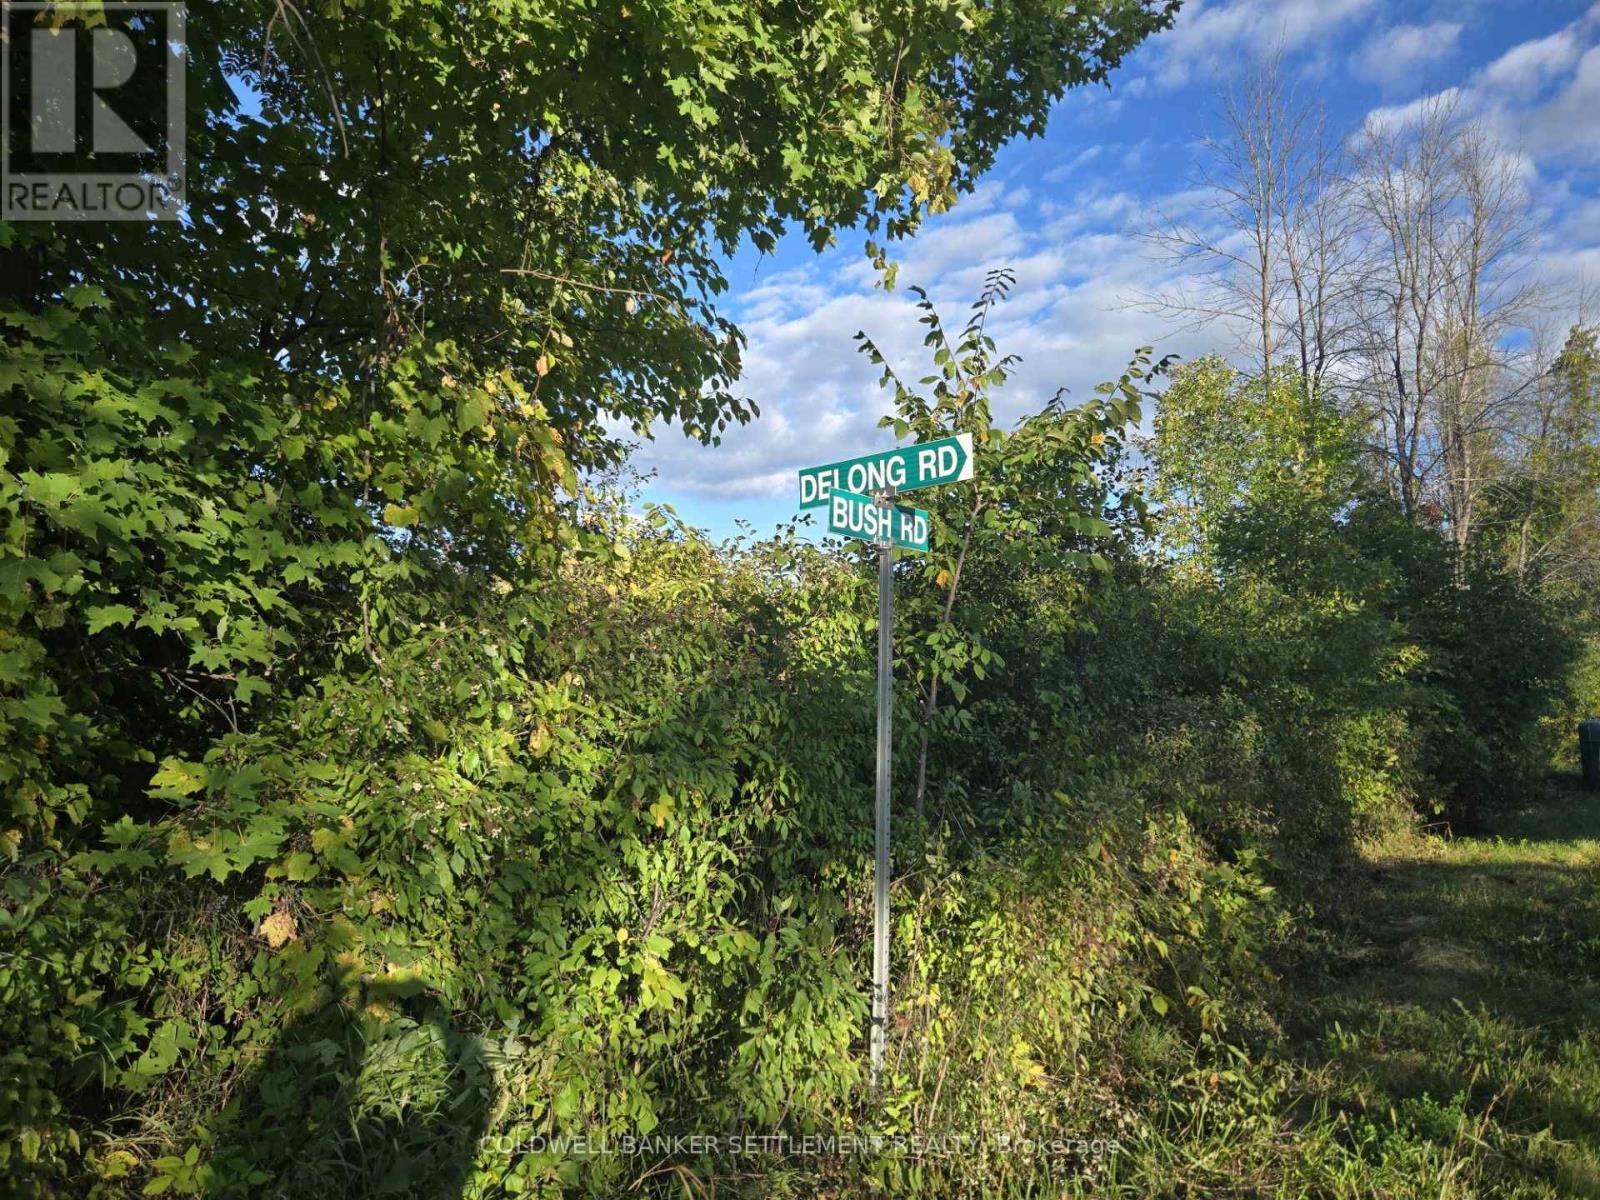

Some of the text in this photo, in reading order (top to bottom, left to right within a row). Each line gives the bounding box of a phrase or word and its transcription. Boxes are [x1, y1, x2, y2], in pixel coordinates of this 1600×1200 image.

[918, 445, 958, 481] RD
[832, 496, 928, 545] BUSH RD
